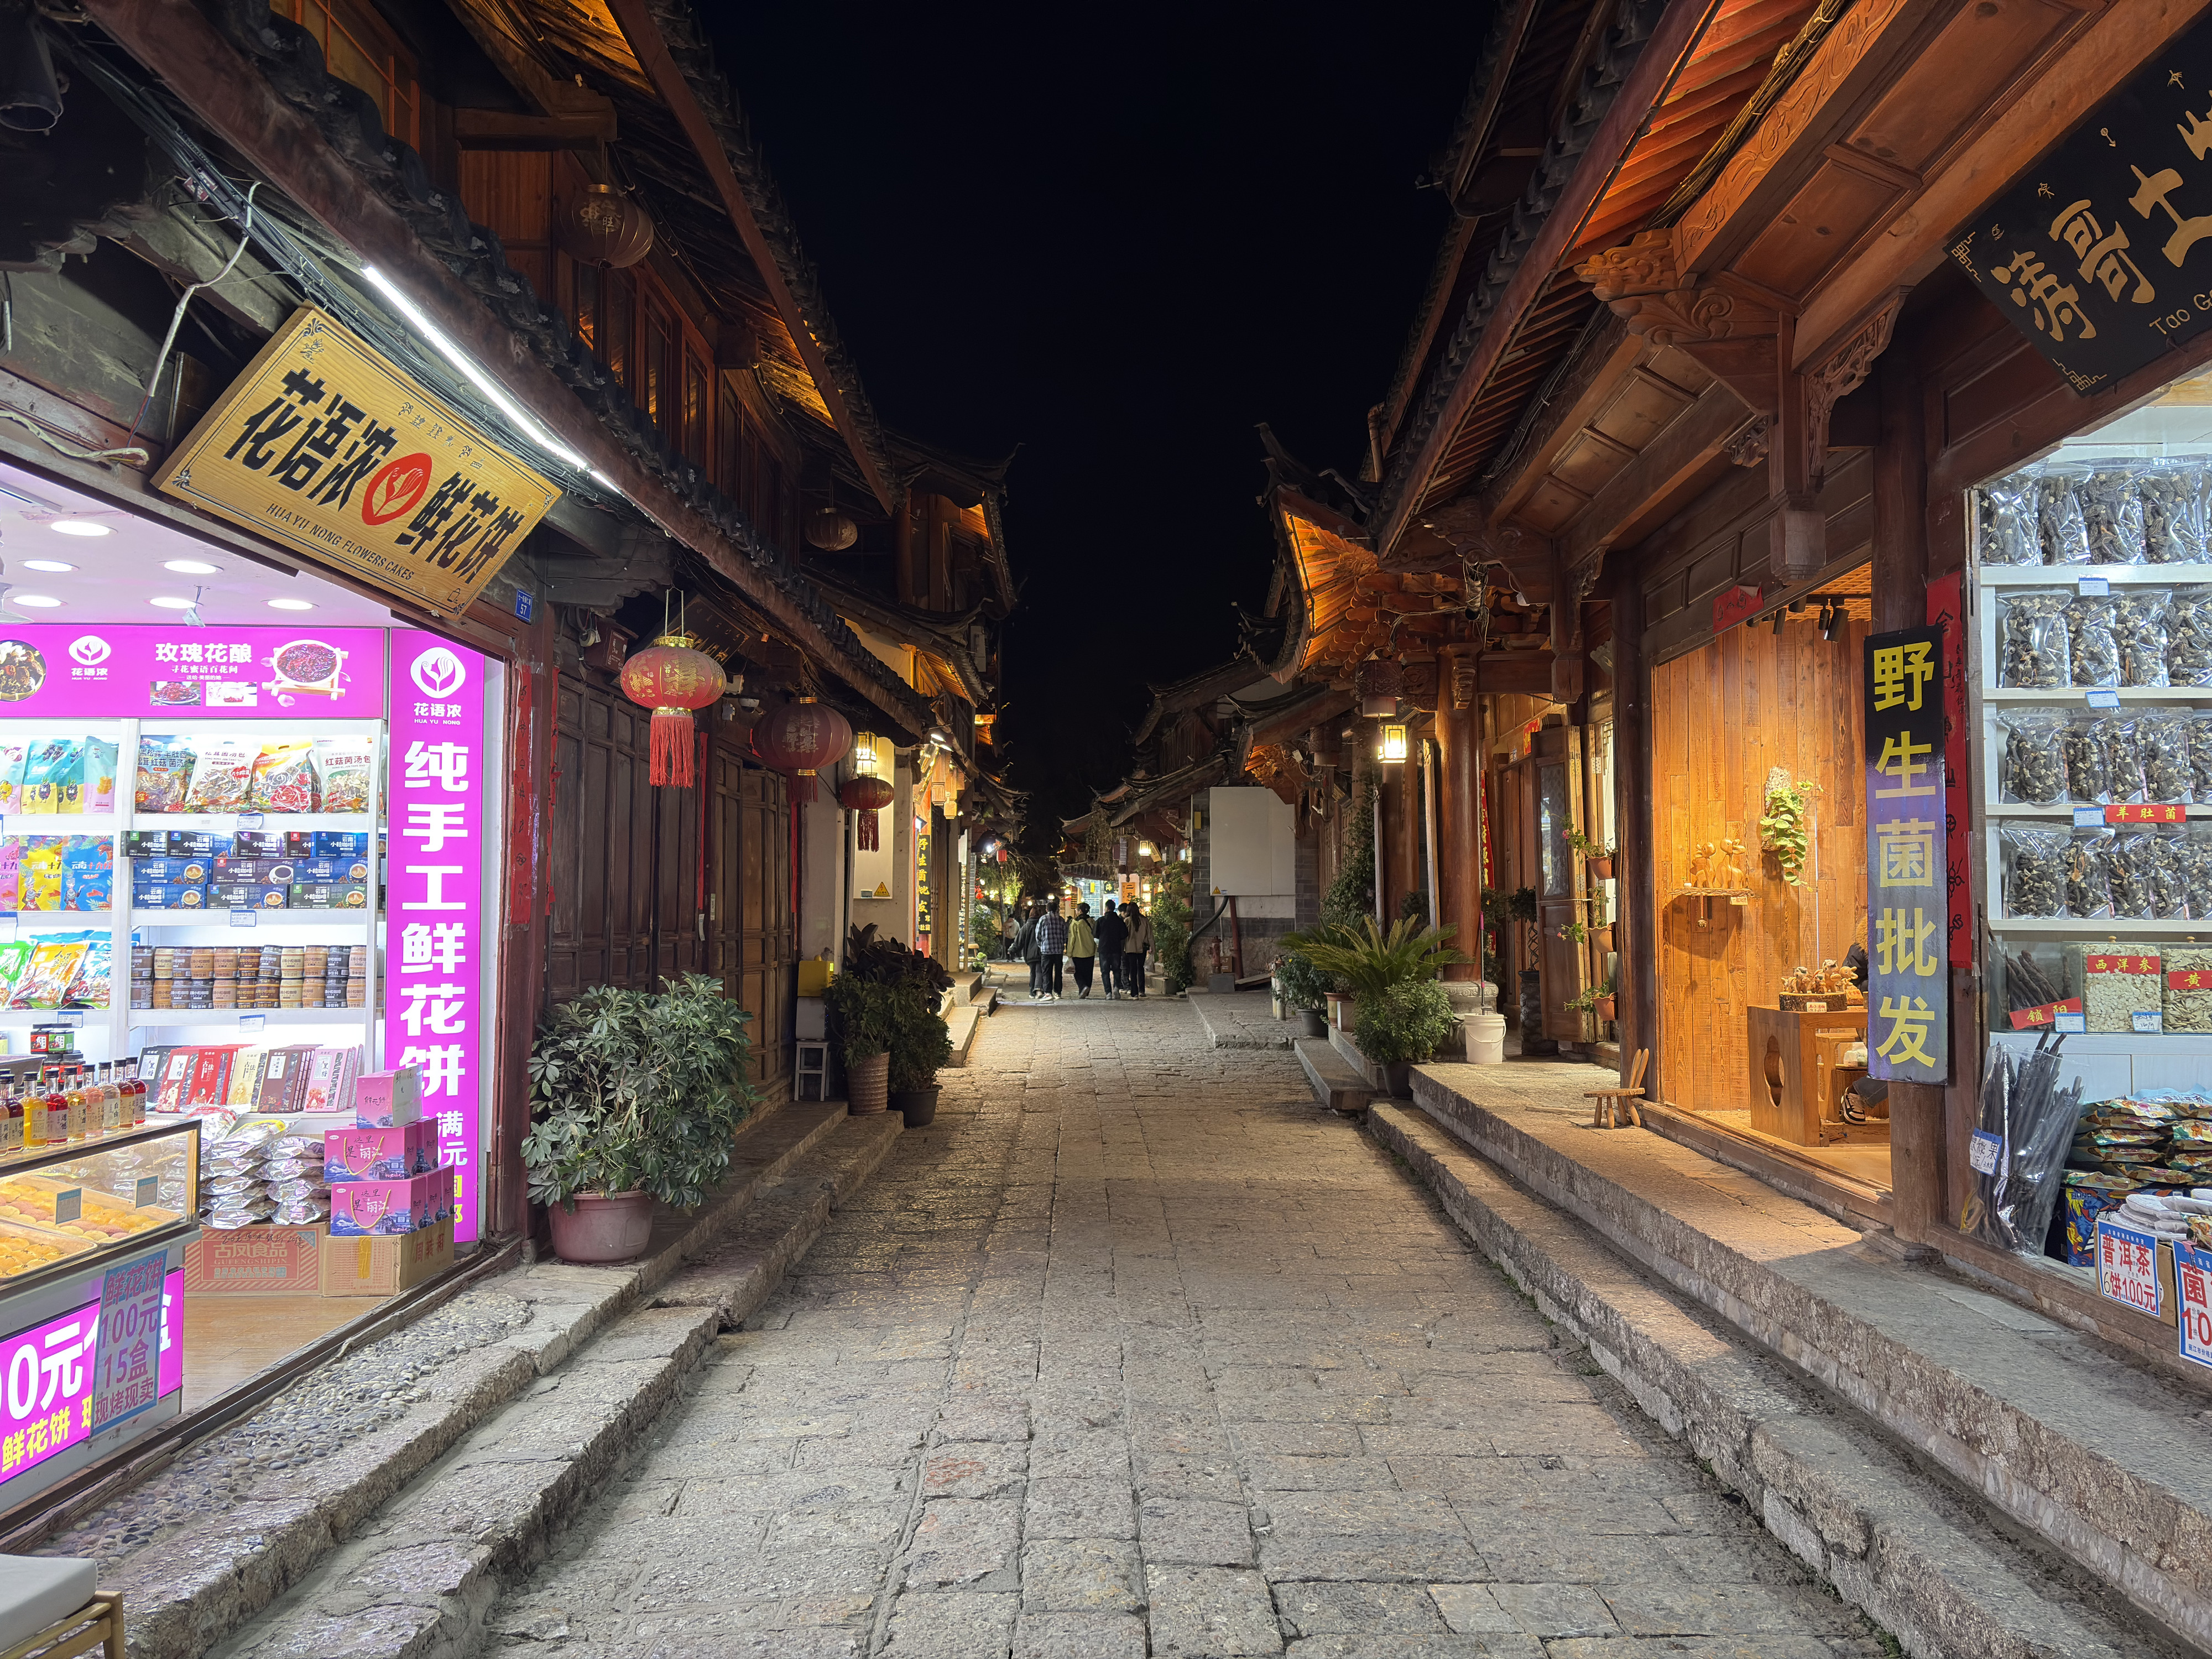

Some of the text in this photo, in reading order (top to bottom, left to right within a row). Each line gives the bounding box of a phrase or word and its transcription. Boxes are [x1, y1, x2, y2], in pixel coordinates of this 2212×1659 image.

[2149, 309, 2190, 335] Tao
[223, 367, 399, 512] 花语浓
[393, 471, 525, 585] 鲜花饼
[265, 503, 415, 581] HUA YU NONG FLOWERS CAKES
[520, 603, 528, 615] 57
[155, 643, 252, 663] 玫瑰花酿
[71, 667, 108, 676] 花语浓
[171, 665, 238, 674] 寻花蜜语百花间
[413, 702, 462, 718] 花语浓
[150, 758, 166, 767] 红菇
[325, 755, 371, 766] 红菇菌汤包
[2116, 806, 2177, 821] 羊肚菌
[1874, 640, 1938, 1068] 野生菌批发
[399, 740, 469, 1097] 纯手工鲜花饼
[2095, 958, 2153, 973] 西洋参
[2184, 972, 2202, 988] 黄
[2027, 1004, 2068, 1022] 锁阳
[113, 1102, 119, 1118] 自由
[354, 1135, 374, 1144] 这里
[346, 1145, 357, 1158] 是
[359, 1147, 383, 1160] 丽江
[437, 1140, 468, 1166] 元
[361, 1188, 380, 1197] 这里
[353, 1199, 364, 1212] 是
[367, 1201, 389, 1213] 丽江
[2102, 1233, 2151, 1277] 普洱茶
[103, 1256, 164, 1309] 鲜花饼
[2179, 1261, 2208, 1308] 菌
[101, 1294, 159, 1349] 100元
[104, 1338, 149, 1390] 15盒
[95, 1377, 154, 1426] 现烤现卖
[2, 1406, 71, 1473] 鲜花饼
